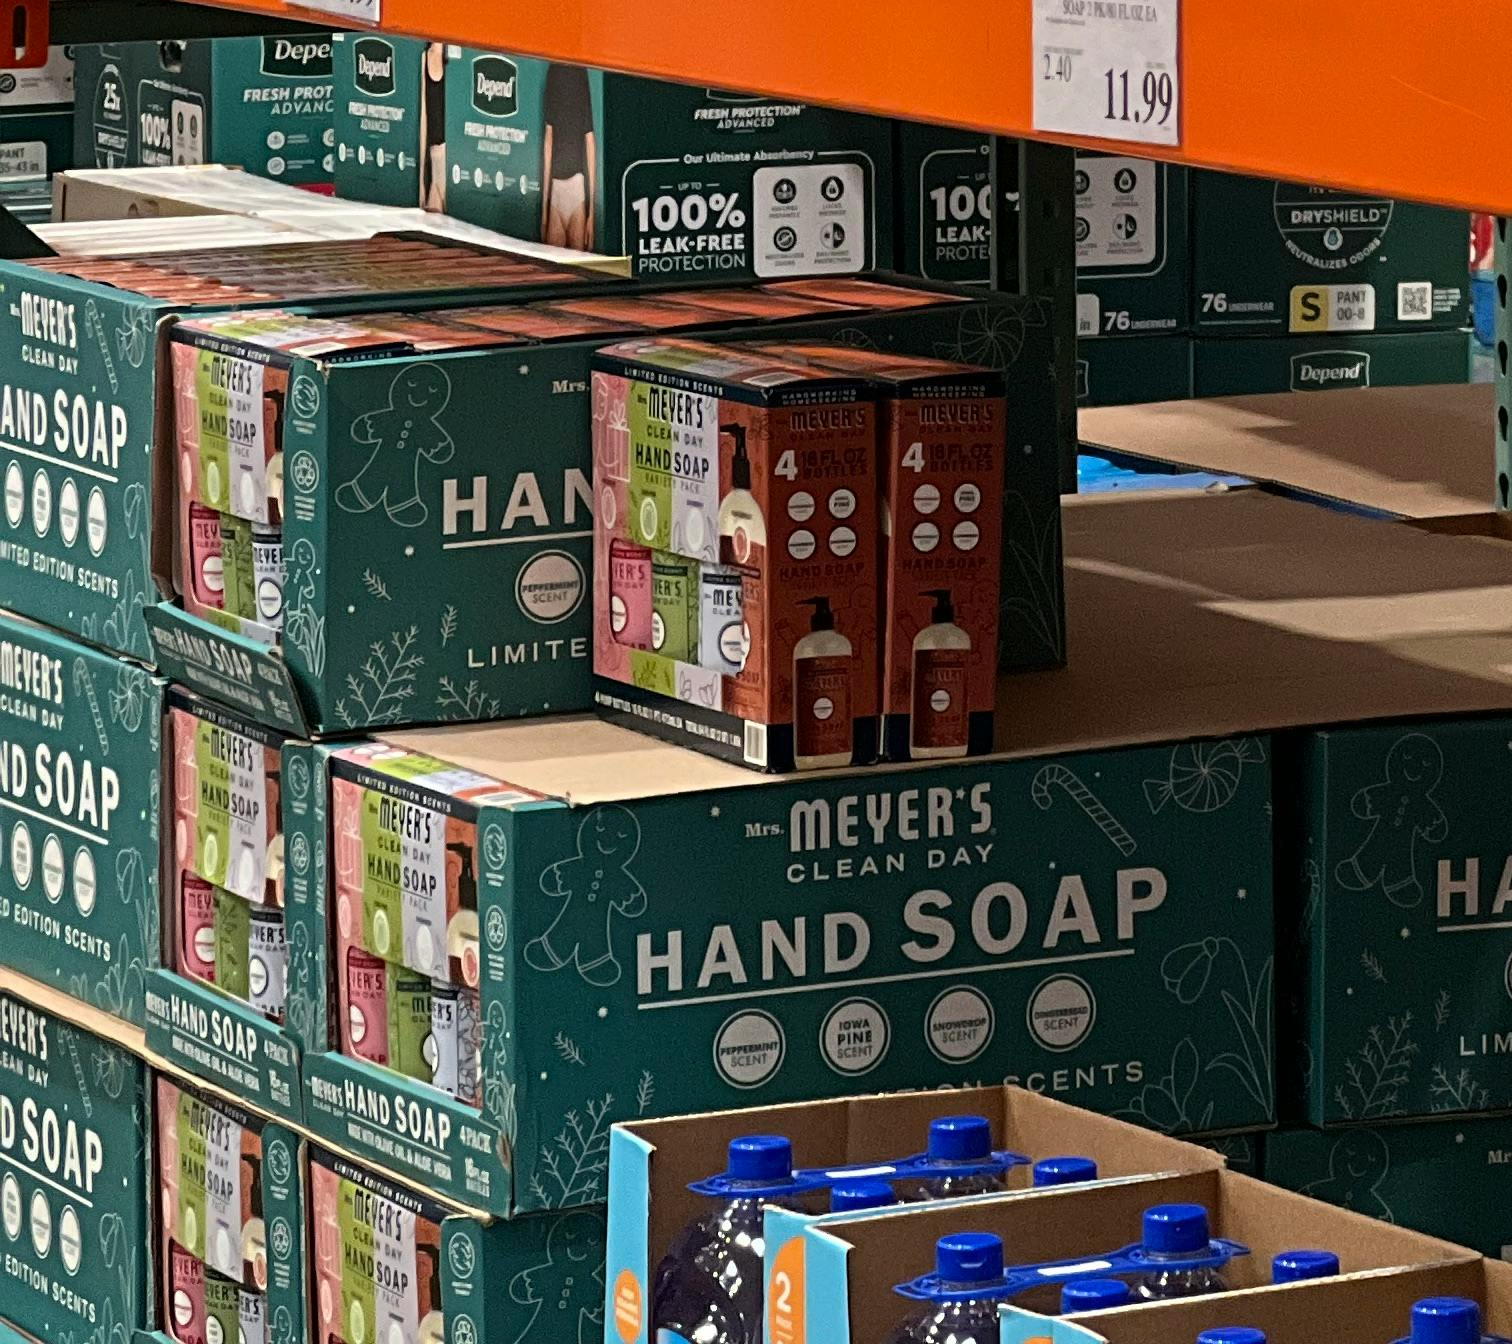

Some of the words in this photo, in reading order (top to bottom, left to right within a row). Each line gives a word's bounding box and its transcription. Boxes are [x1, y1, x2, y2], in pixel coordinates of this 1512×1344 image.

[1063, 0, 1084, 16] SOAP
[1146, 6, 1157, 22] EA
[1043, 54, 1072, 82] 2.40
[476, 72, 516, 101] Depend
[1105, 68, 1172, 125] 11.99
[695, 108, 728, 121] FRESH
[717, 117, 774, 129] ADVANCED
[684, 153, 703, 164] Our
[706, 151, 750, 163] Ultimate
[753, 148, 814, 164] Absorbency
[632, 192, 746, 232] 100%
[639, 233, 744, 254] LEAK-FREE
[1285, 239, 1347, 270] NEUTRALIZES
[1349, 237, 1382, 265] ODORS
[638, 254, 745, 273] PROTECTION
[1202, 293, 1227, 312] 76
[1301, 292, 1320, 322] S
[21, 292, 77, 348] MEYER'S
[1301, 363, 1362, 383] Depend
[648, 386, 704, 430] MEYER'S
[647, 426, 679, 441] CLEAN
[684, 432, 704, 449] DAY
[636, 444, 671, 471] HAND
[673, 452, 709, 480] SOAP
[774, 450, 798, 481] 4
[745, 822, 784, 838] Mrs.
[790, 782, 996, 853] MEYER'S
[786, 853, 905, 884] CLEAN
[927, 843, 995, 871] DAY
[638, 912, 870, 995] HAND
[901, 867, 1167, 963] SOAP
[839, 1017, 870, 1033] IOWA
[932, 1017, 987, 1033] SNOWDROP
[1043, 1017, 1079, 1031] SCENT
[837, 1030, 872, 1046] PINE
[942, 1029, 978, 1043] SCENT
[720, 1041, 779, 1058] PEPPERMINT
[731, 1052, 767, 1067] SCENT
[836, 1044, 873, 1060] SCENT
[1003, 1061, 1143, 1089] SCENTS
